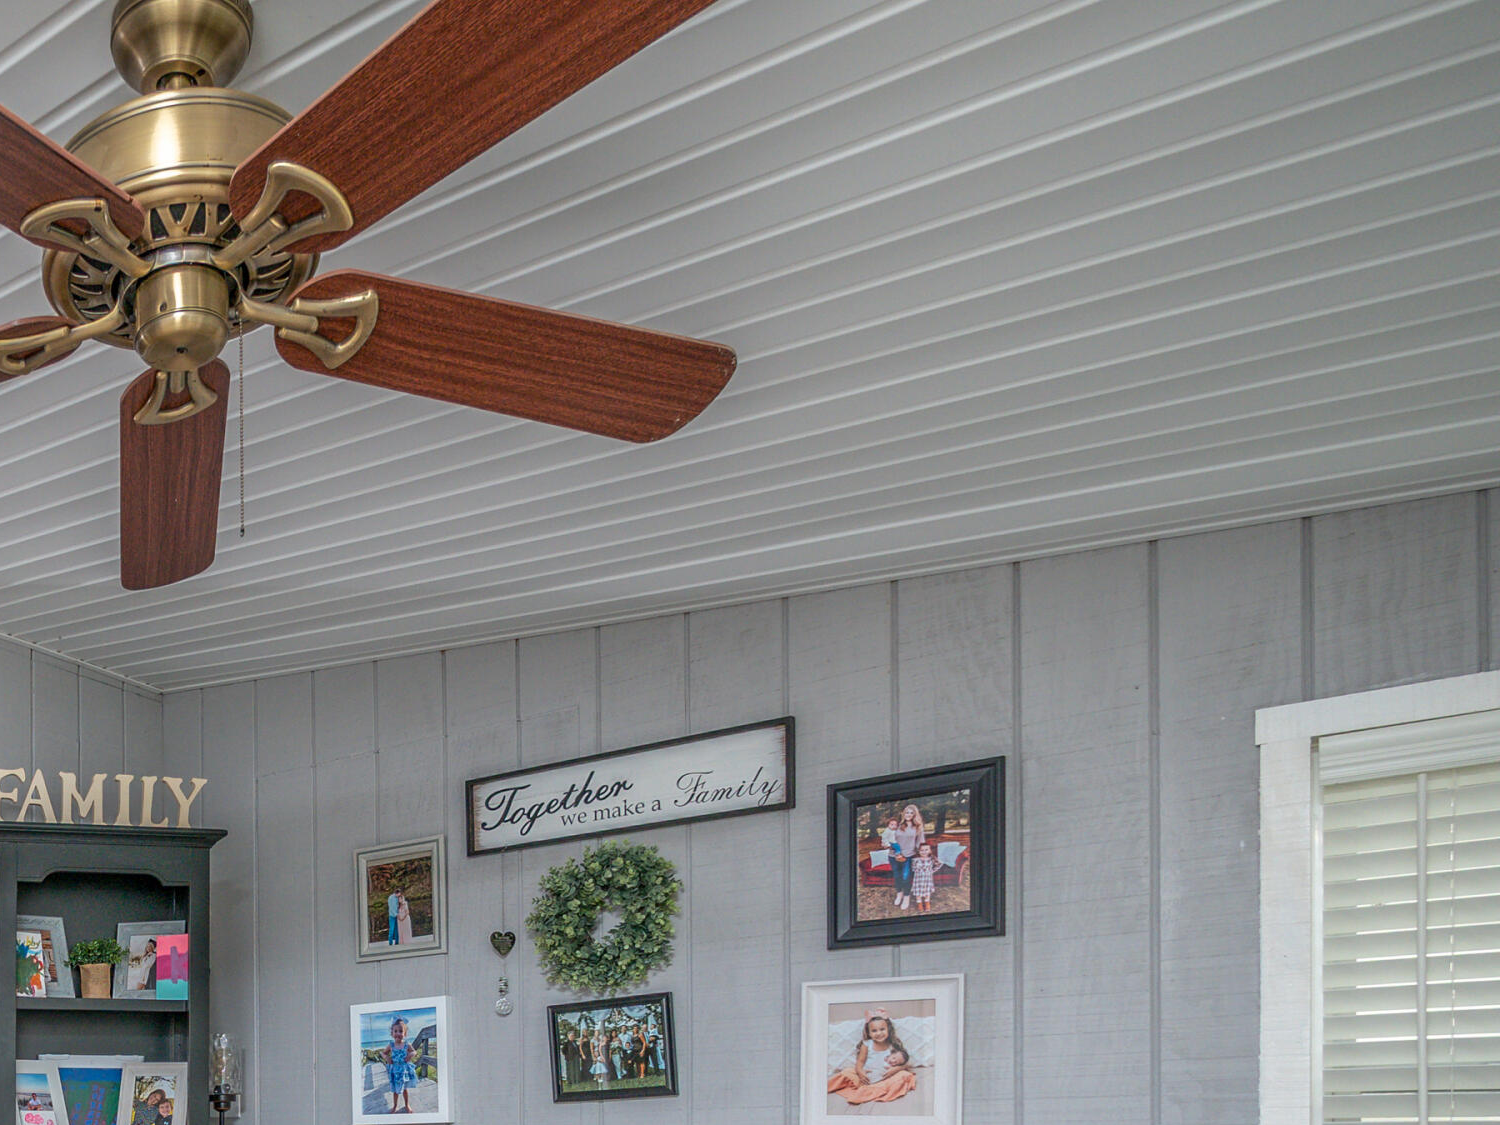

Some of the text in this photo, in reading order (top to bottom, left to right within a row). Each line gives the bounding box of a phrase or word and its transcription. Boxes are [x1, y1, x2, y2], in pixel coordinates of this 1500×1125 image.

[480, 770, 634, 836] Together
[673, 766, 783, 807] Family
[560, 798, 662, 827] we make a
